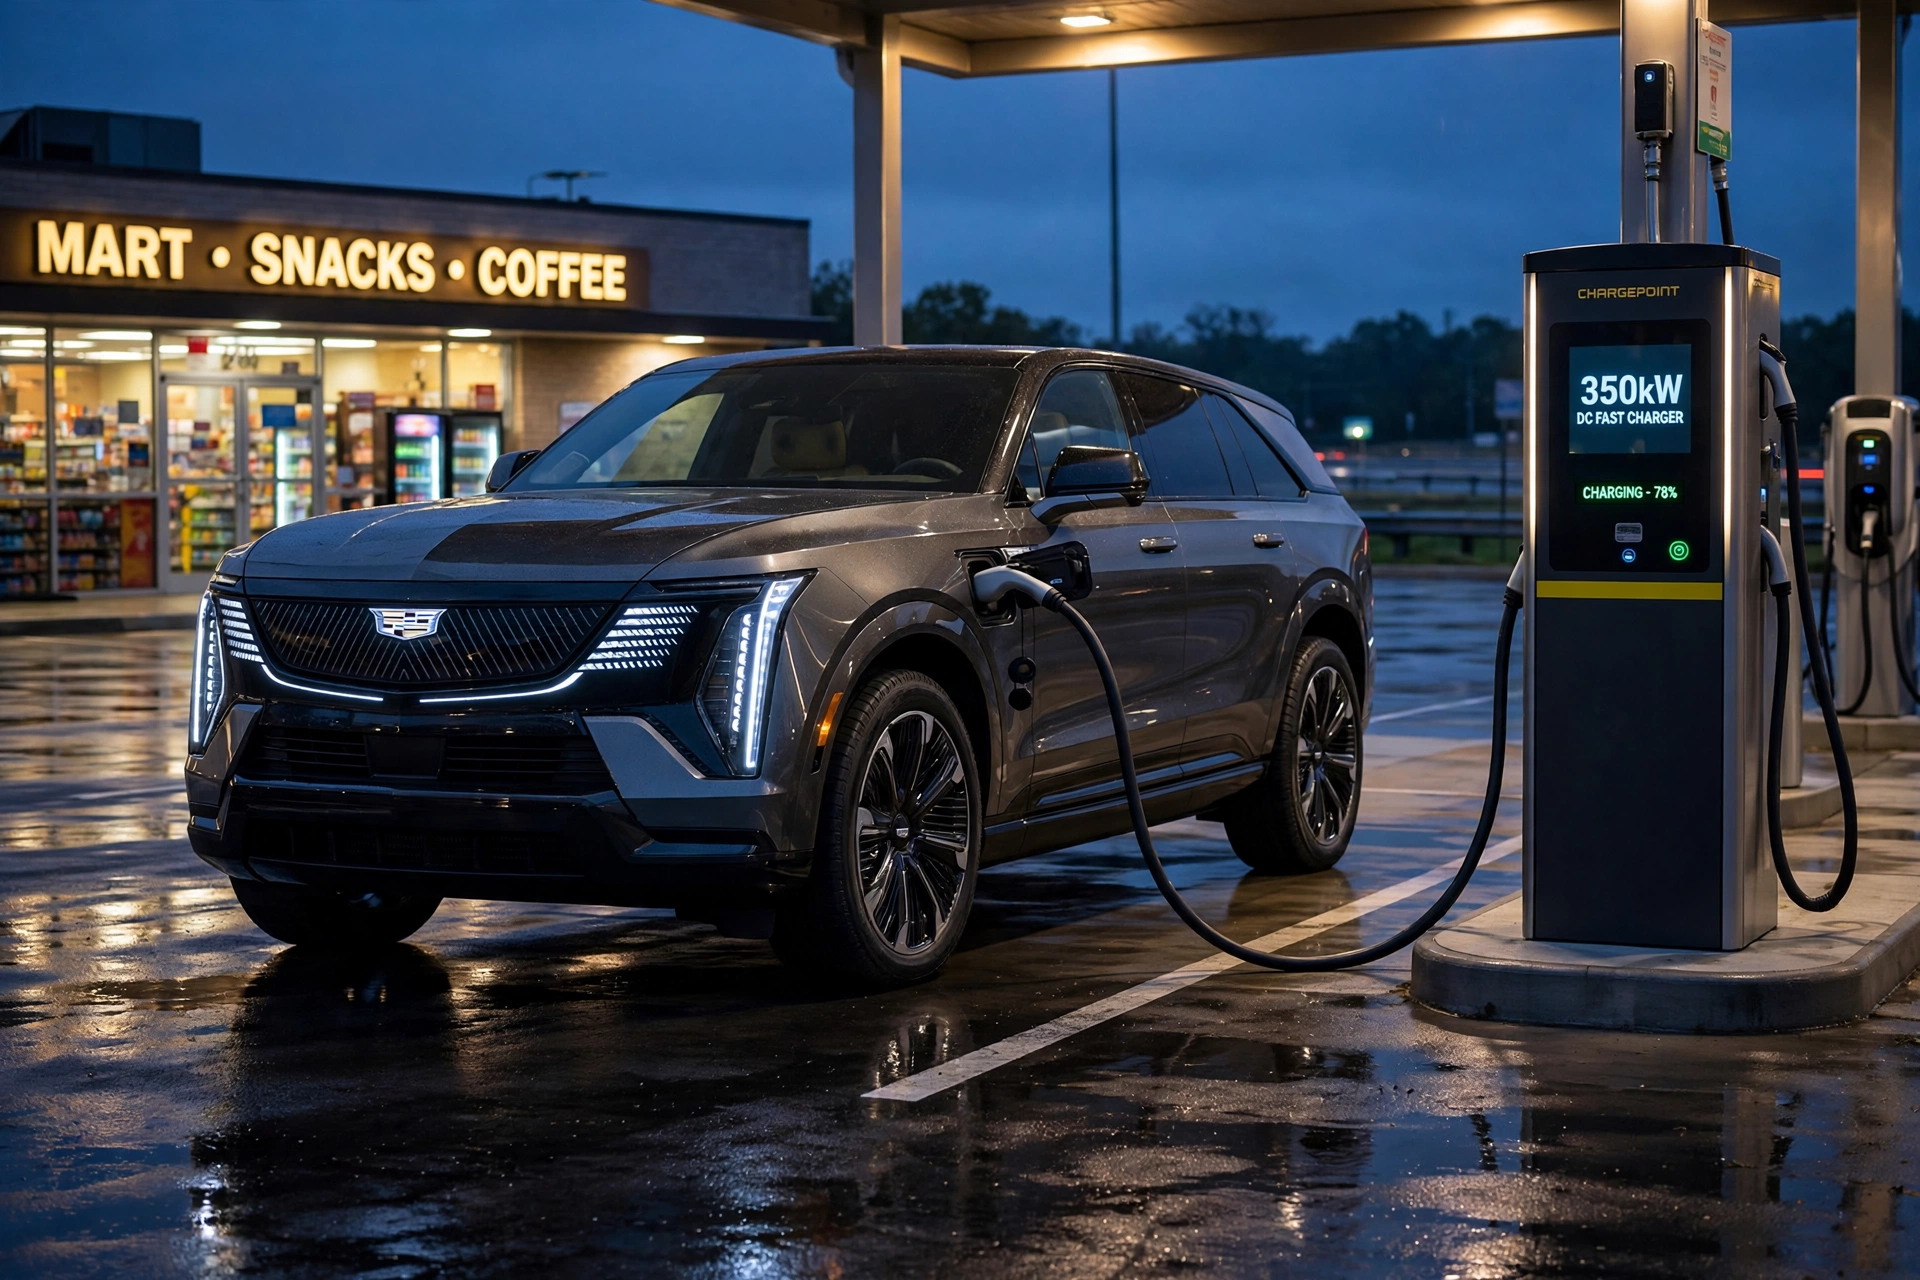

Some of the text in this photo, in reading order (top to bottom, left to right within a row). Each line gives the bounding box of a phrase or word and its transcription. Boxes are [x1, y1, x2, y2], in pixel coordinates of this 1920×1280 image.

[37, 219, 193, 280] MART
[250, 231, 436, 293] SNACKS
[478, 246, 627, 302] COFFEE
[1577, 285, 1680, 299] CHARGEPOINT
[1580, 374, 1684, 406] 350kW
[1576, 410, 1685, 425] DC FAST CHARGER
[1582, 485, 1644, 500] CHARGING
[1653, 485, 1678, 500] 78%
